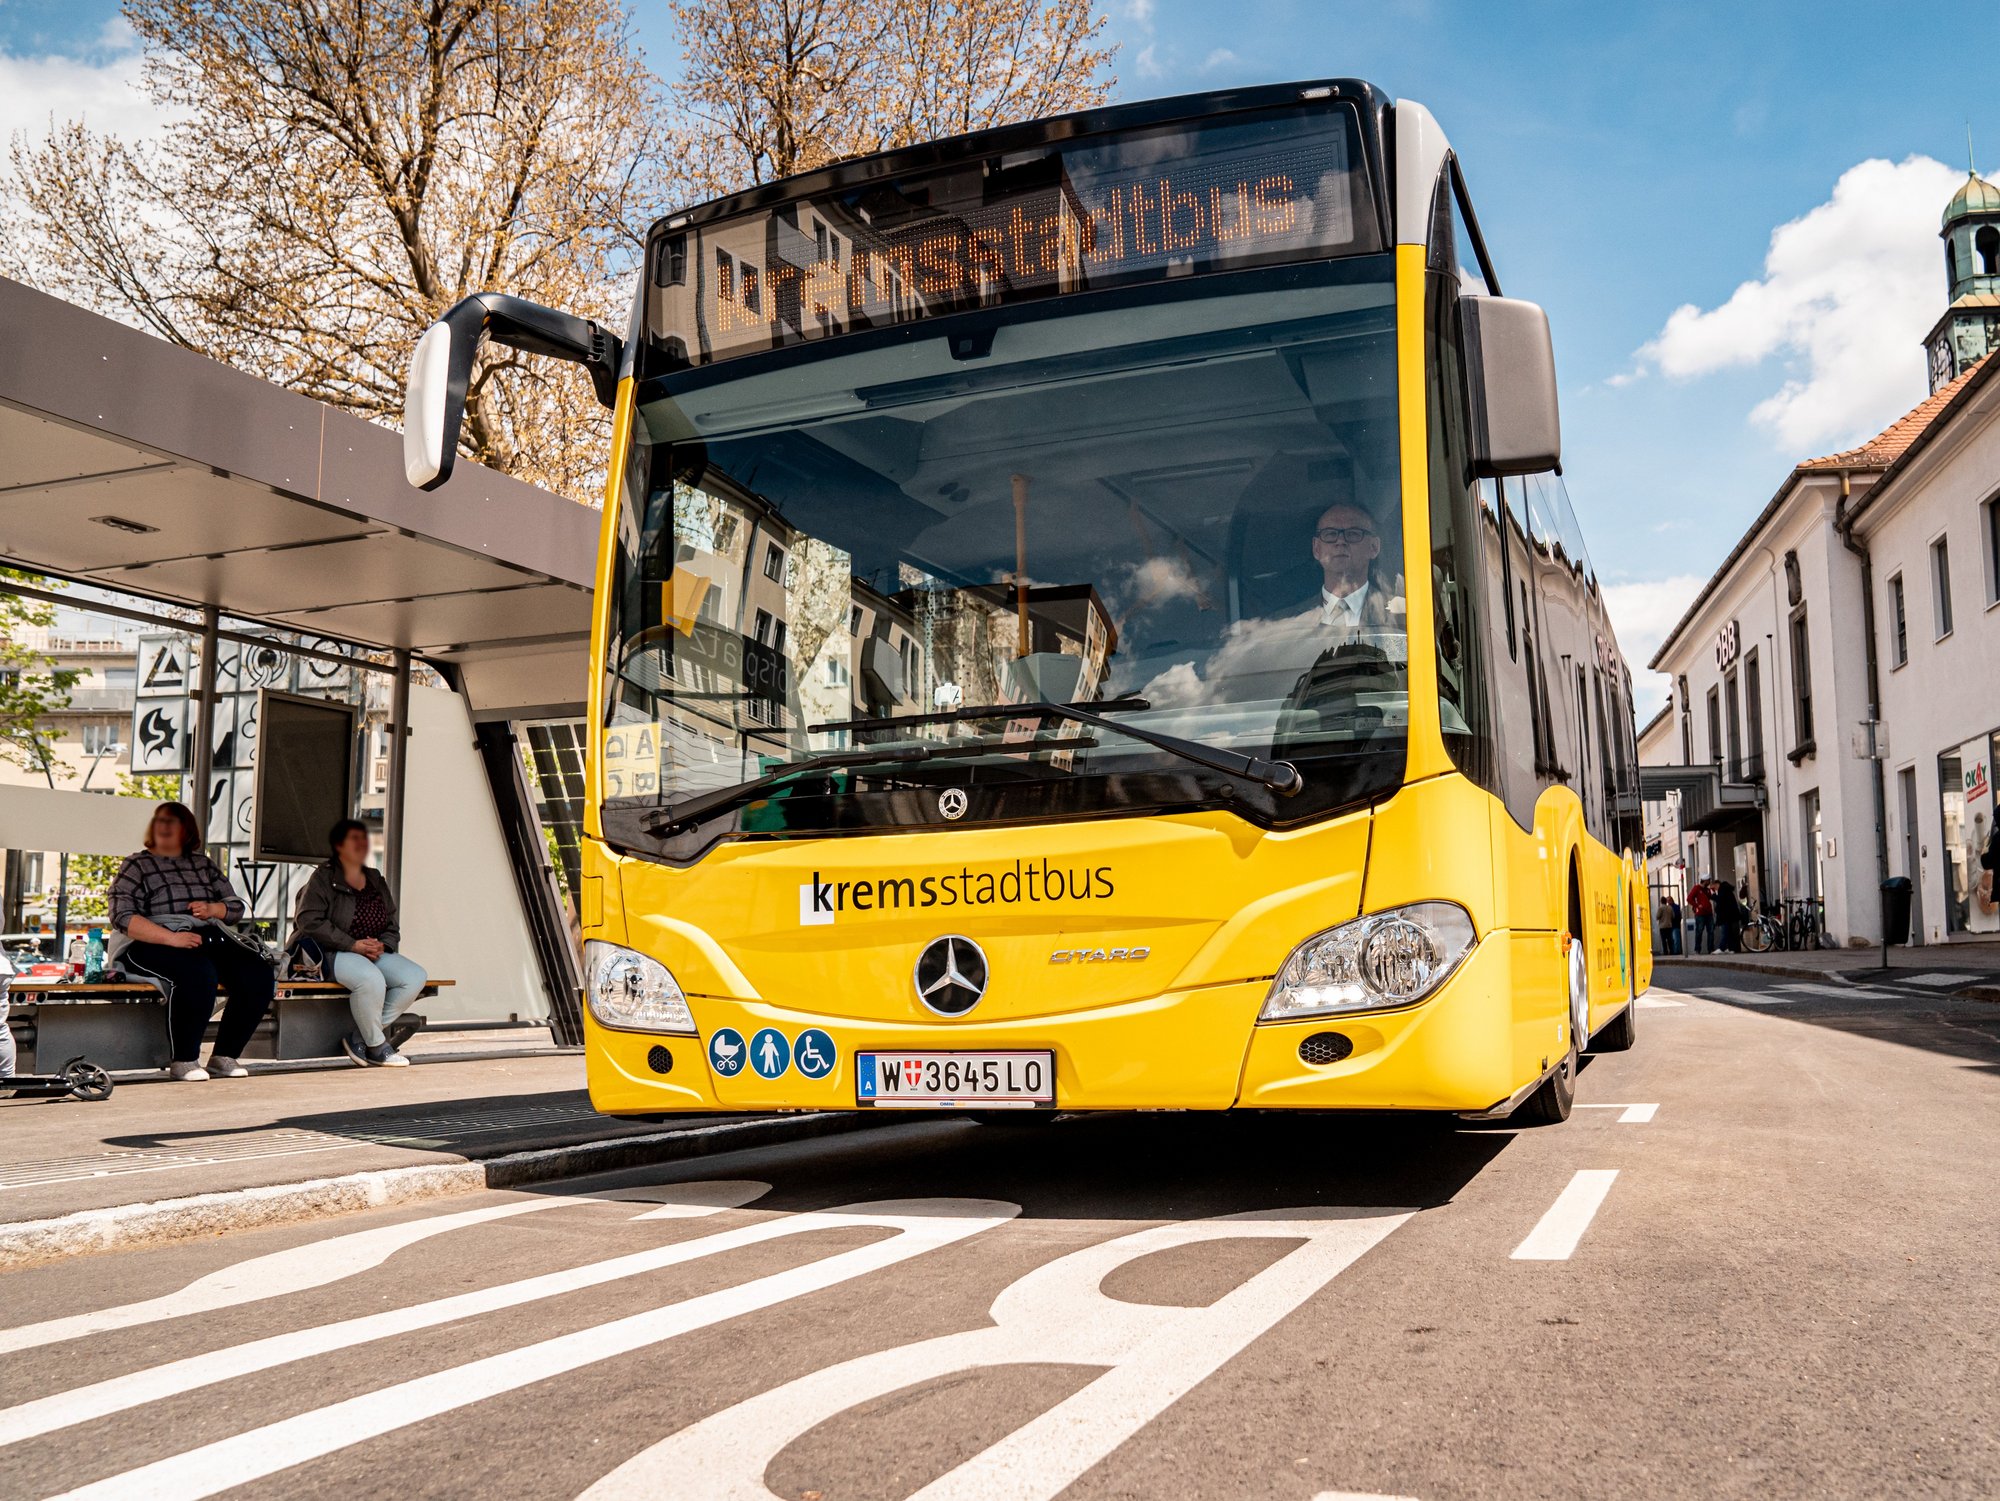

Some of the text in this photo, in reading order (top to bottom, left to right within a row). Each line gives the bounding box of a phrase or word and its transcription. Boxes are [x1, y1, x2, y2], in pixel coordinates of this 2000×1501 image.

[1965, 761, 1987, 788] OKAY
[812, 858, 1115, 912] kremsstadtbus
[1051, 946, 1151, 963] CITARO
[881, 1061, 901, 1092] W
